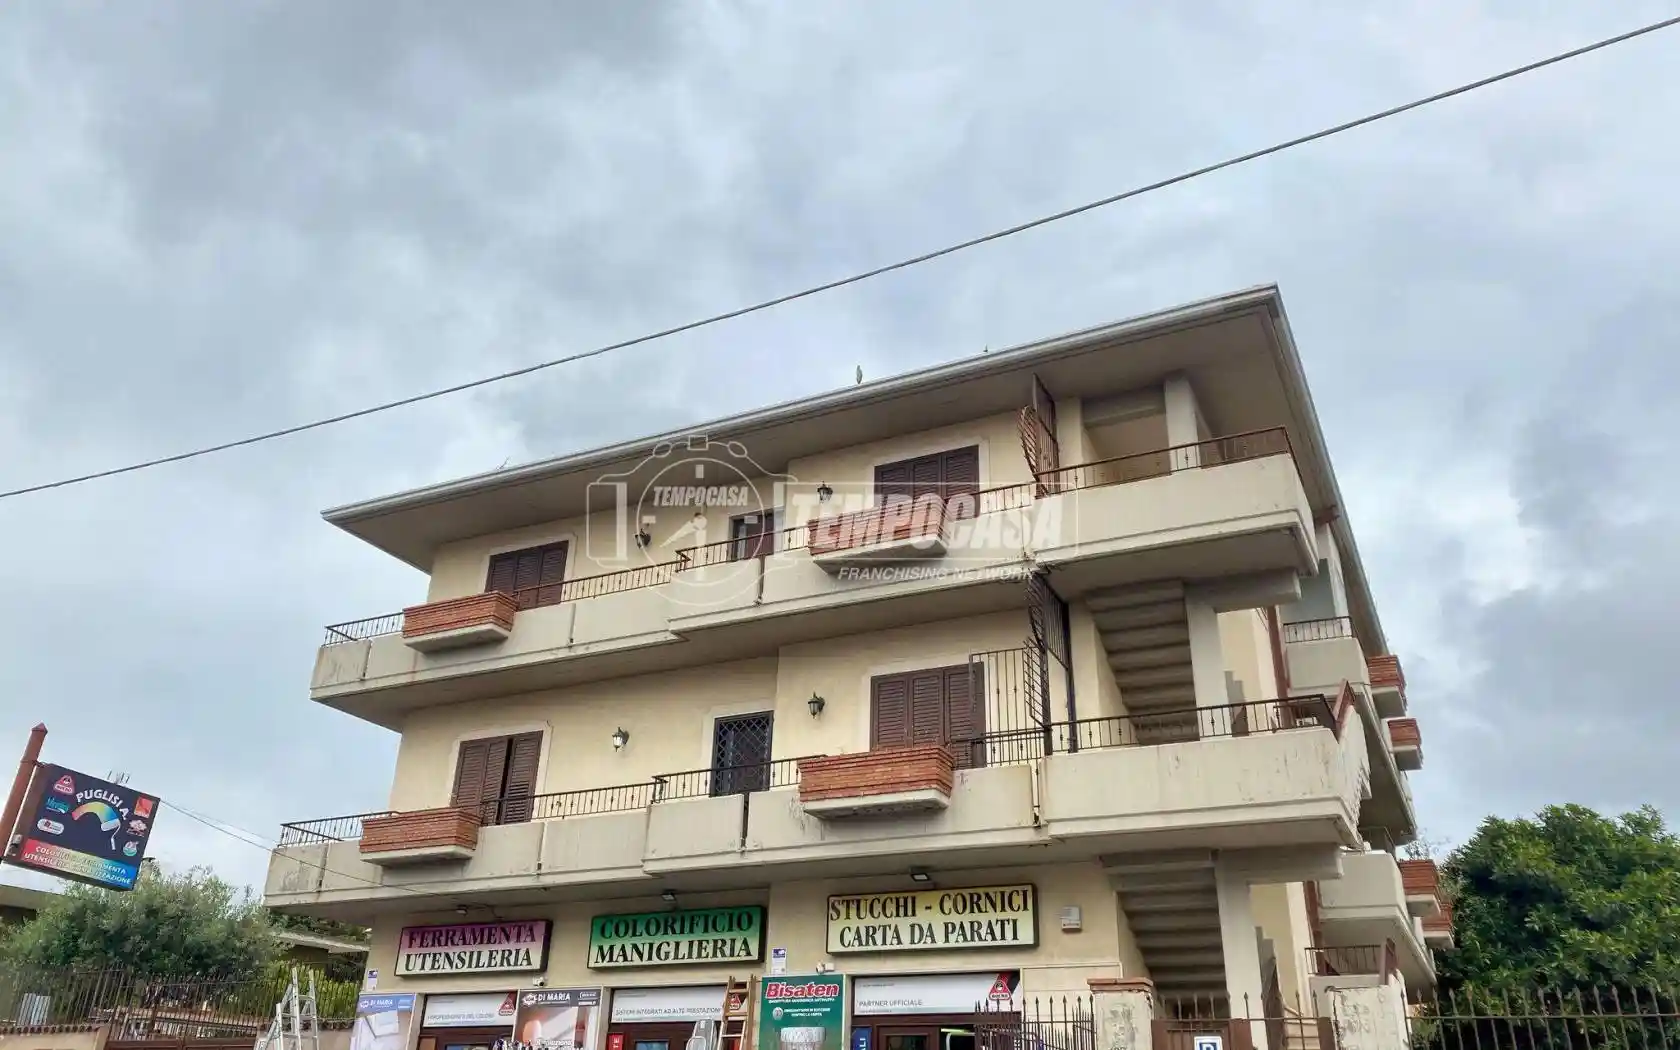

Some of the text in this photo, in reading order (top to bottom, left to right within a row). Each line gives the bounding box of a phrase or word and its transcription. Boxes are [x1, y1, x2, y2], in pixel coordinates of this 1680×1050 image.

[75, 788, 123, 808] PUGLISI
[830, 895, 916, 921] STUCCHI
[939, 889, 1029, 916] CORNICI
[407, 923, 536, 949] FERRAMENTA
[600, 911, 753, 939] COLORIFICIO
[839, 919, 1019, 948] CARTA DA PARATI
[404, 948, 533, 972] UTENSILERIA
[594, 937, 753, 964] MANIGLIERIA
[538, 993, 546, 1002] DI
[547, 992, 571, 1001] MARIA
[765, 982, 840, 999] Bisaten
[889, 998, 923, 1006] UFFICIALE
